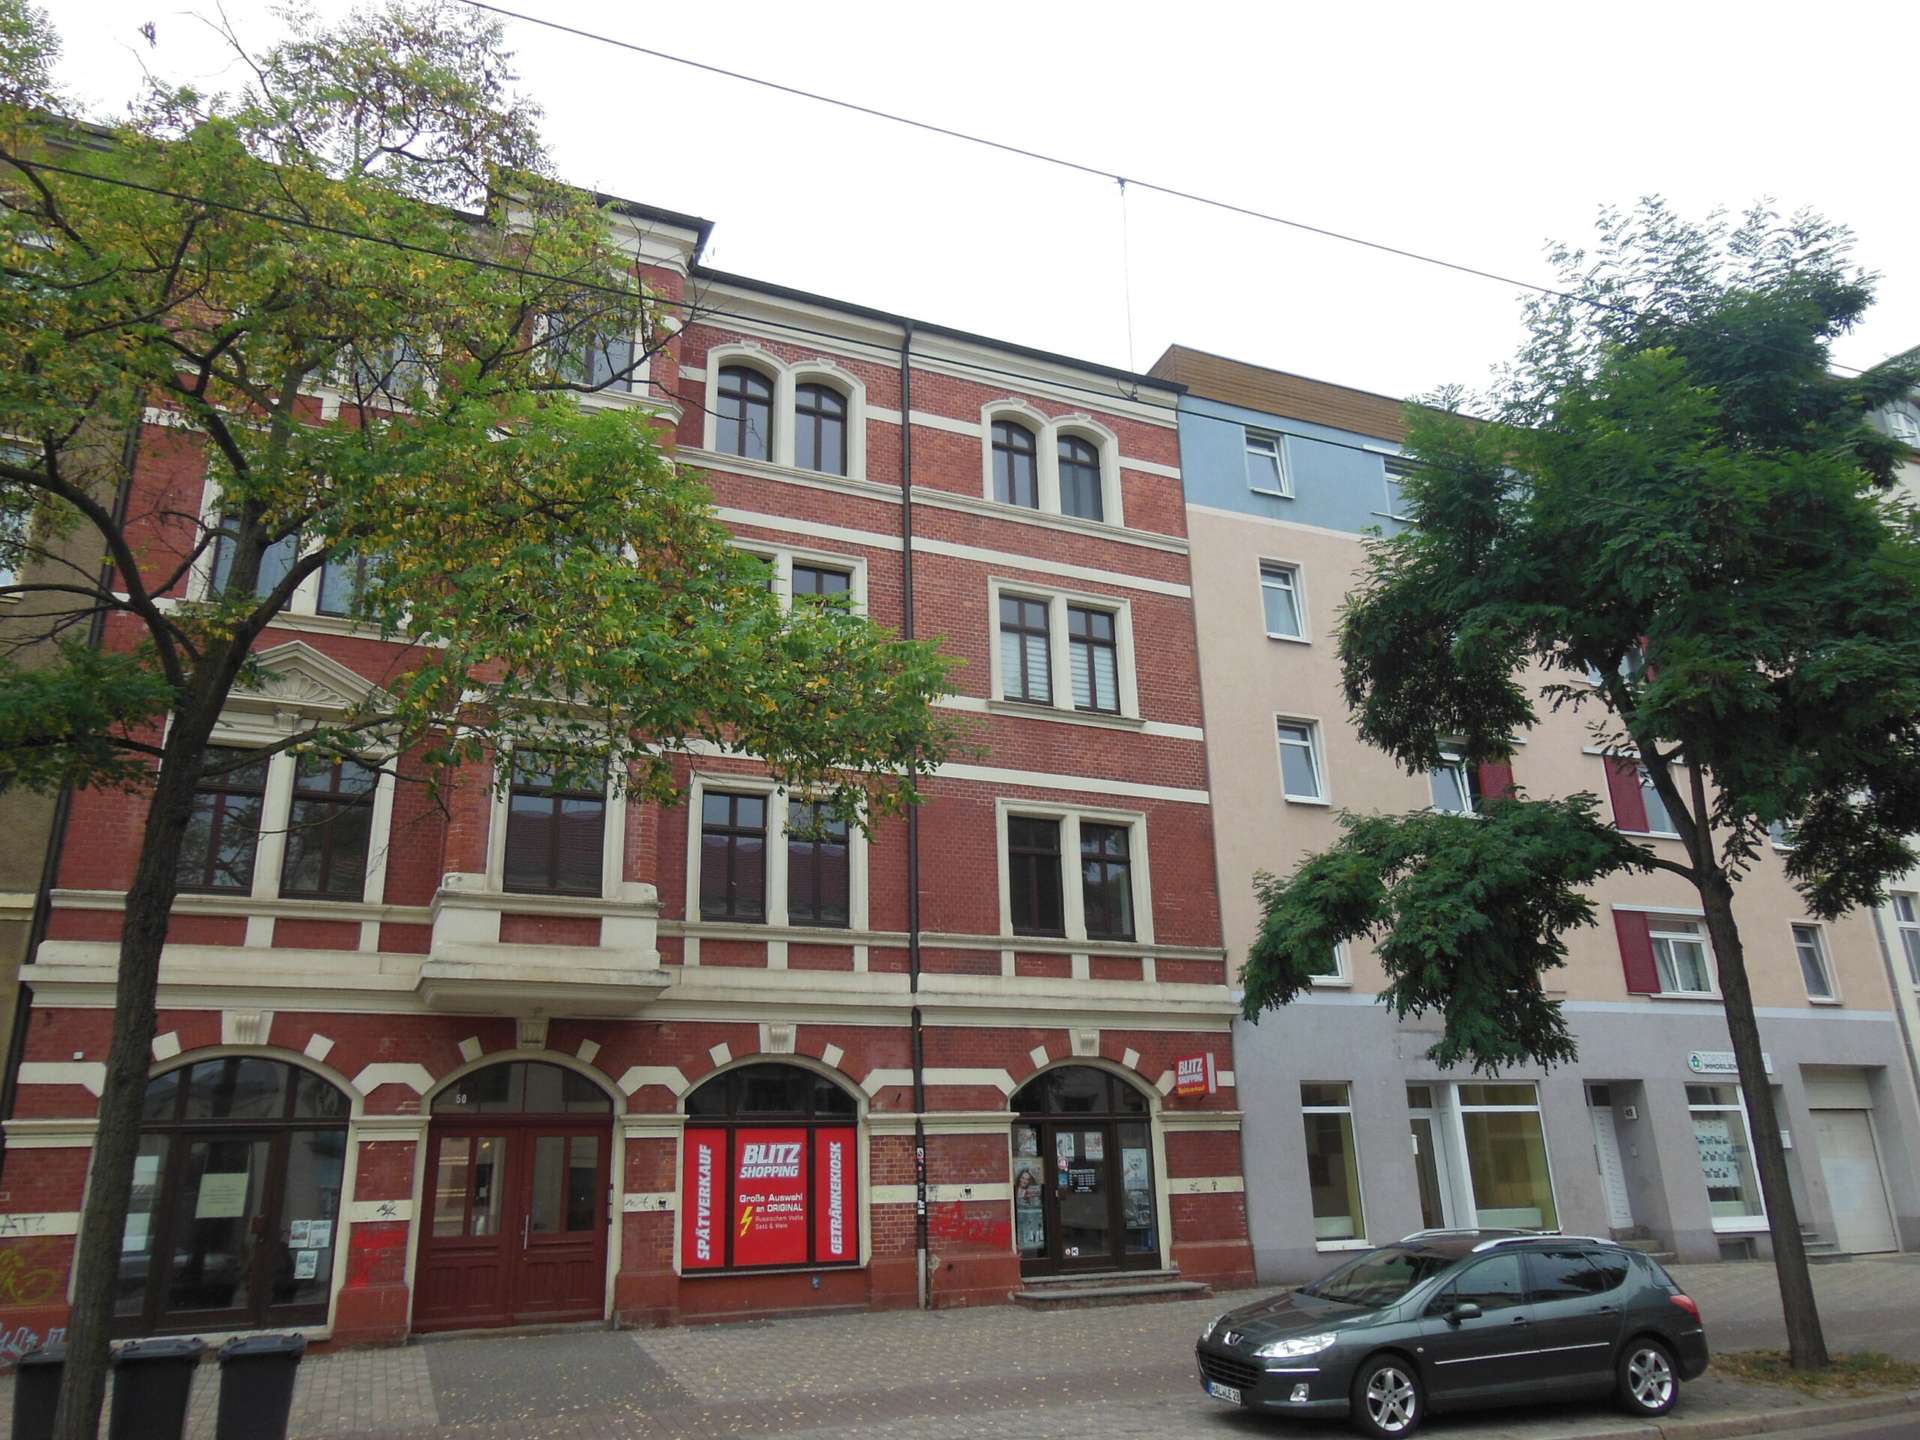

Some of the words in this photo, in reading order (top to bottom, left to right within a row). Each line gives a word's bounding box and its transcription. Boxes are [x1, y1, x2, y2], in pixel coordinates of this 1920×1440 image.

[1178, 1057, 1203, 1075] BLITZ
[743, 1143, 801, 1164] BLITZ
[739, 1165, 799, 1179] SHOPPING
[696, 1143, 712, 1260] SPÄTVERKAUF
[739, 1194, 765, 1203] Große
[768, 1193, 803, 1202] Auswahl
[829, 1141, 842, 1254] GETRÄNKEKIOSK
[767, 1203, 803, 1212] ORIGINAL
